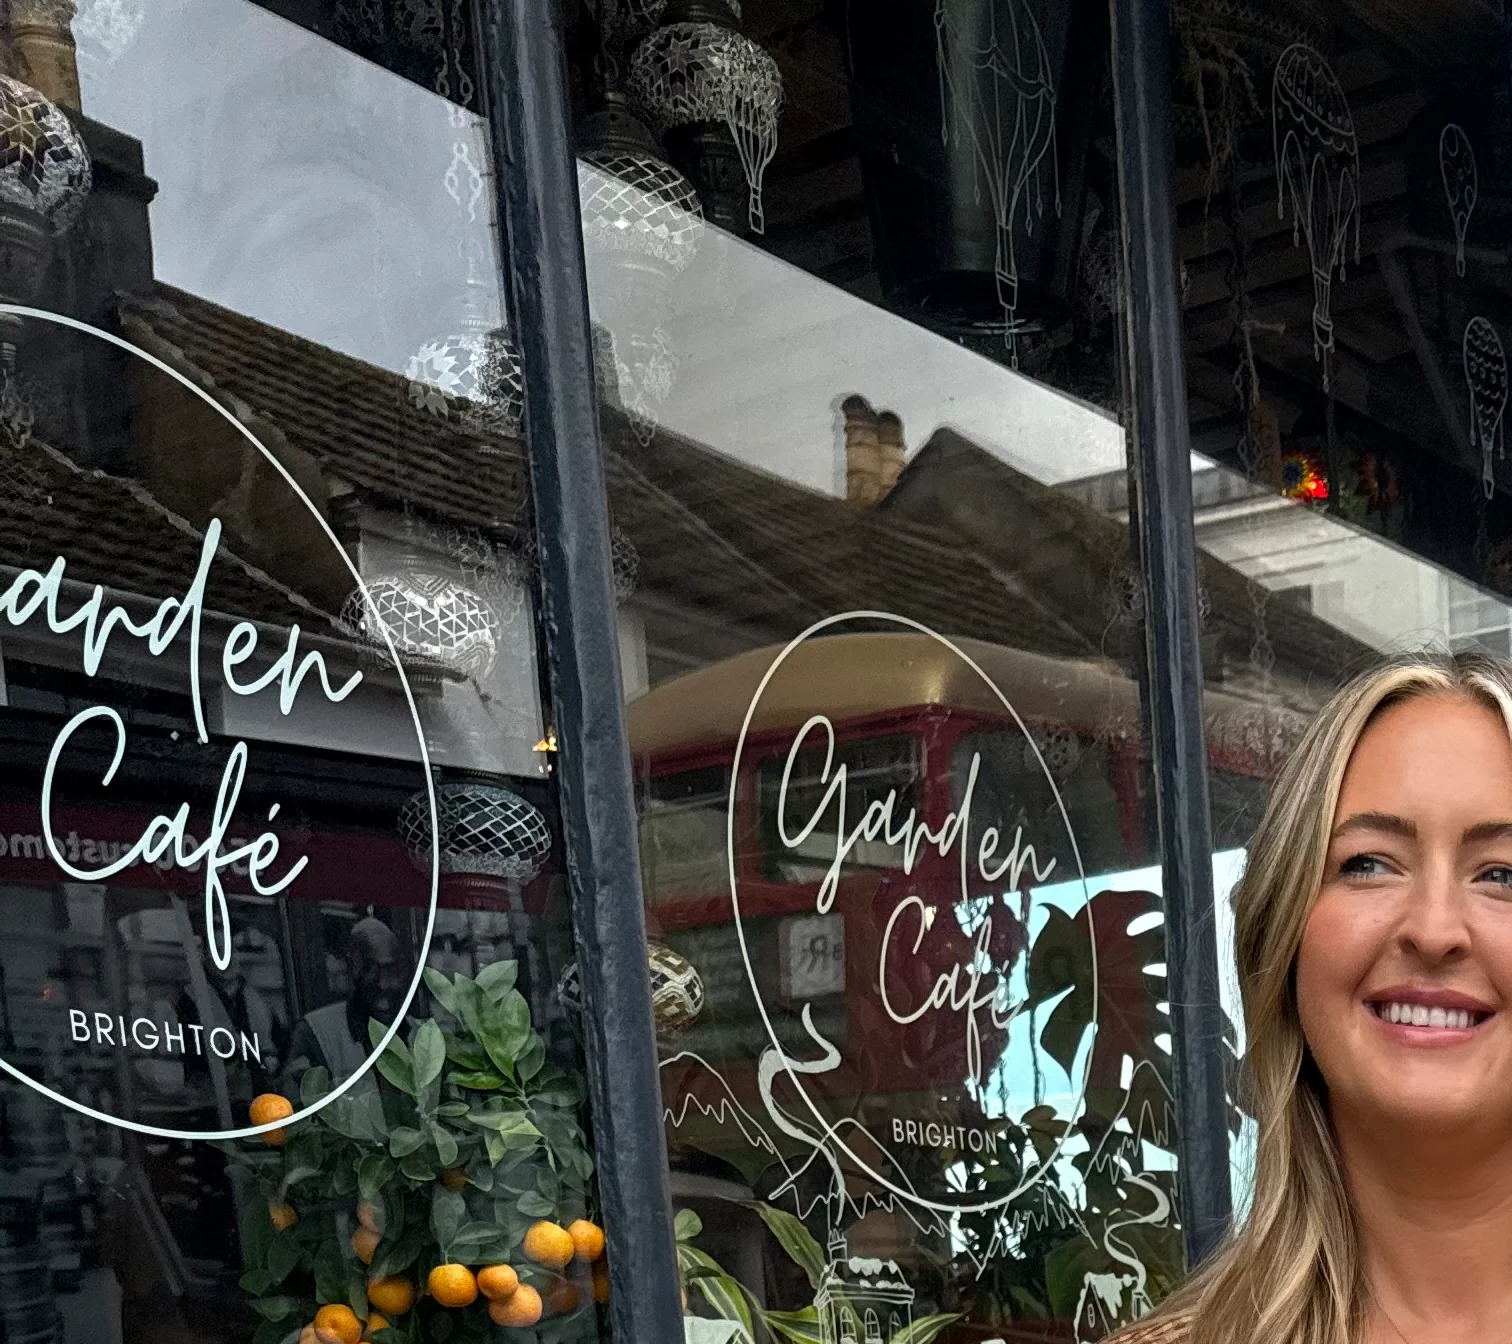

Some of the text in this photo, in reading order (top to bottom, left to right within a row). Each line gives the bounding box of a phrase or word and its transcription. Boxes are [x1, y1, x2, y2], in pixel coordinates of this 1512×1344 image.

[0, 518, 362, 743] arden
[42, 706, 308, 970] Café
[778, 715, 1056, 914] Garden
[69, 1008, 261, 1064] BRIGHTON
[880, 895, 1024, 1085] Café
[892, 1118, 997, 1154] BRIGHTON
